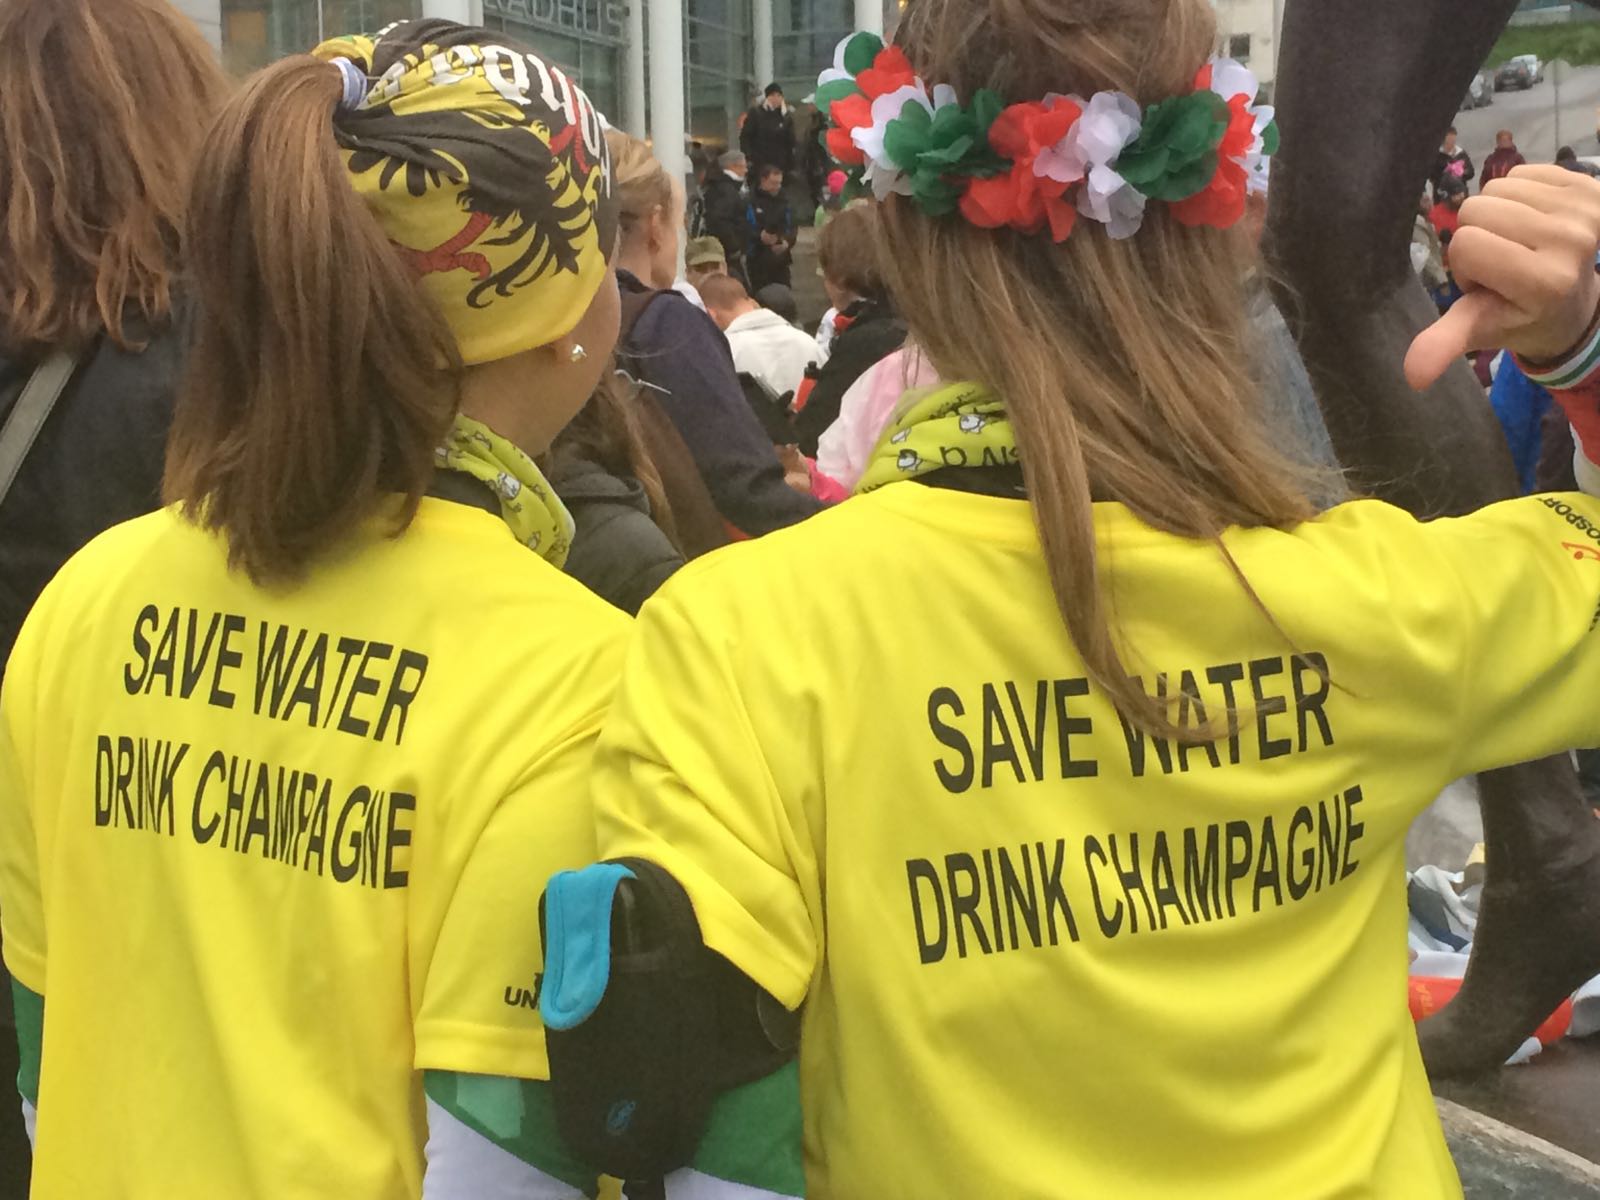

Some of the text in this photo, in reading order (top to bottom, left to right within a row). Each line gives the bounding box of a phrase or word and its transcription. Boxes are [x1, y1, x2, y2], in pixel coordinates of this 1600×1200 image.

[124, 604, 429, 745] SAVE WATER
[927, 677, 1098, 794] SAVE
[95, 735, 416, 889] DRINK CHAMPAGNE
[905, 784, 1366, 964] DRINK CHAMPAGNE
